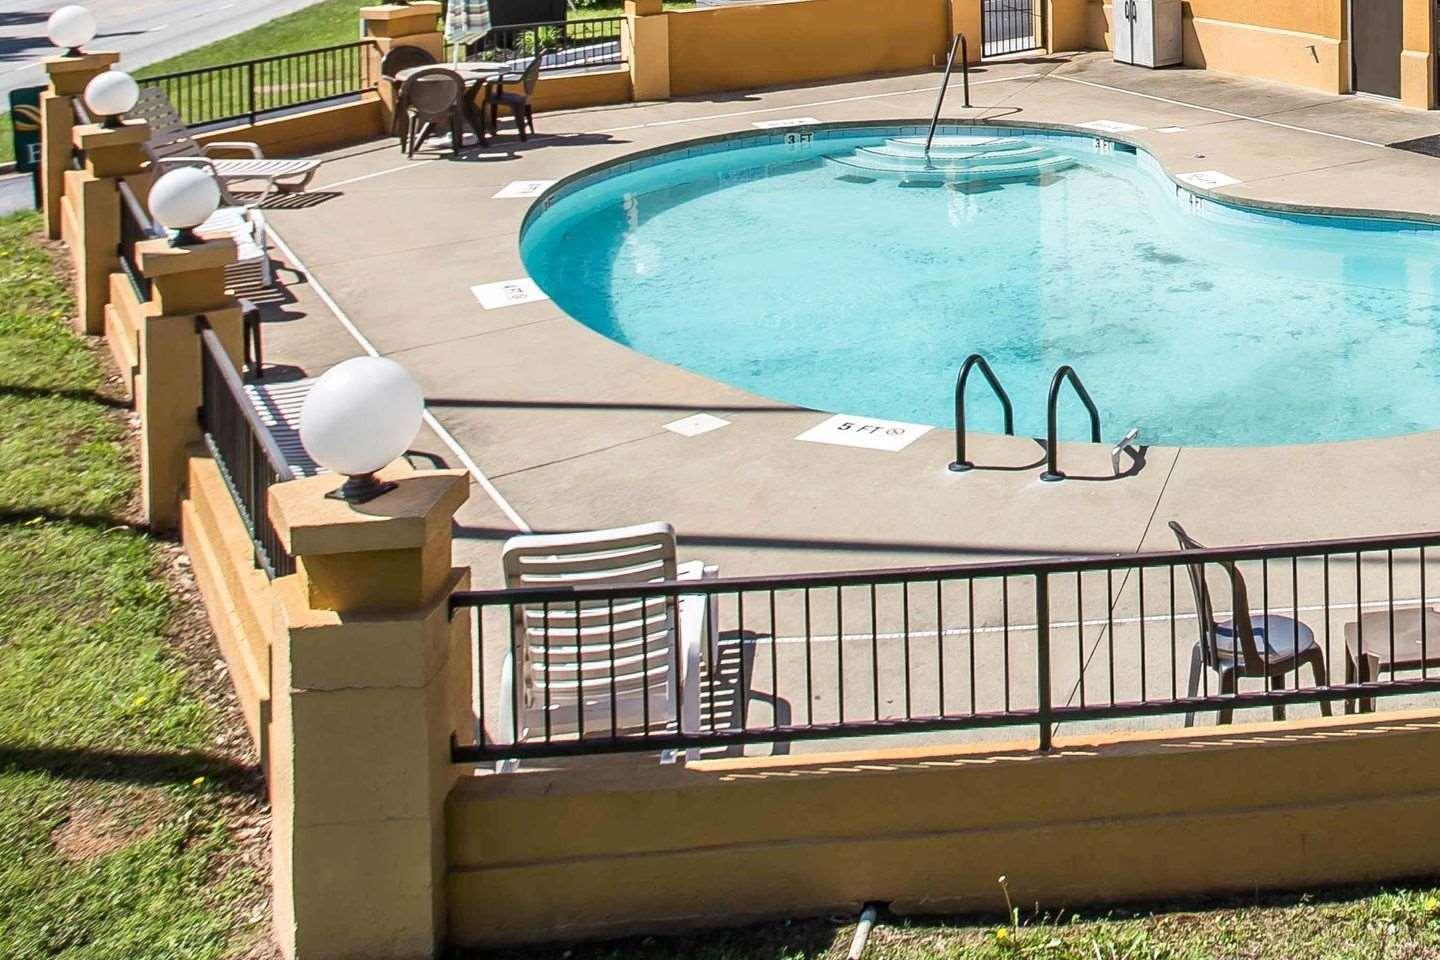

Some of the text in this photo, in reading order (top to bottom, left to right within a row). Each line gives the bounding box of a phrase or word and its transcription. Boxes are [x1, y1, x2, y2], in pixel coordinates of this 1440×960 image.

[799, 133, 812, 143] FT
[837, 421, 886, 435] 5 FT
